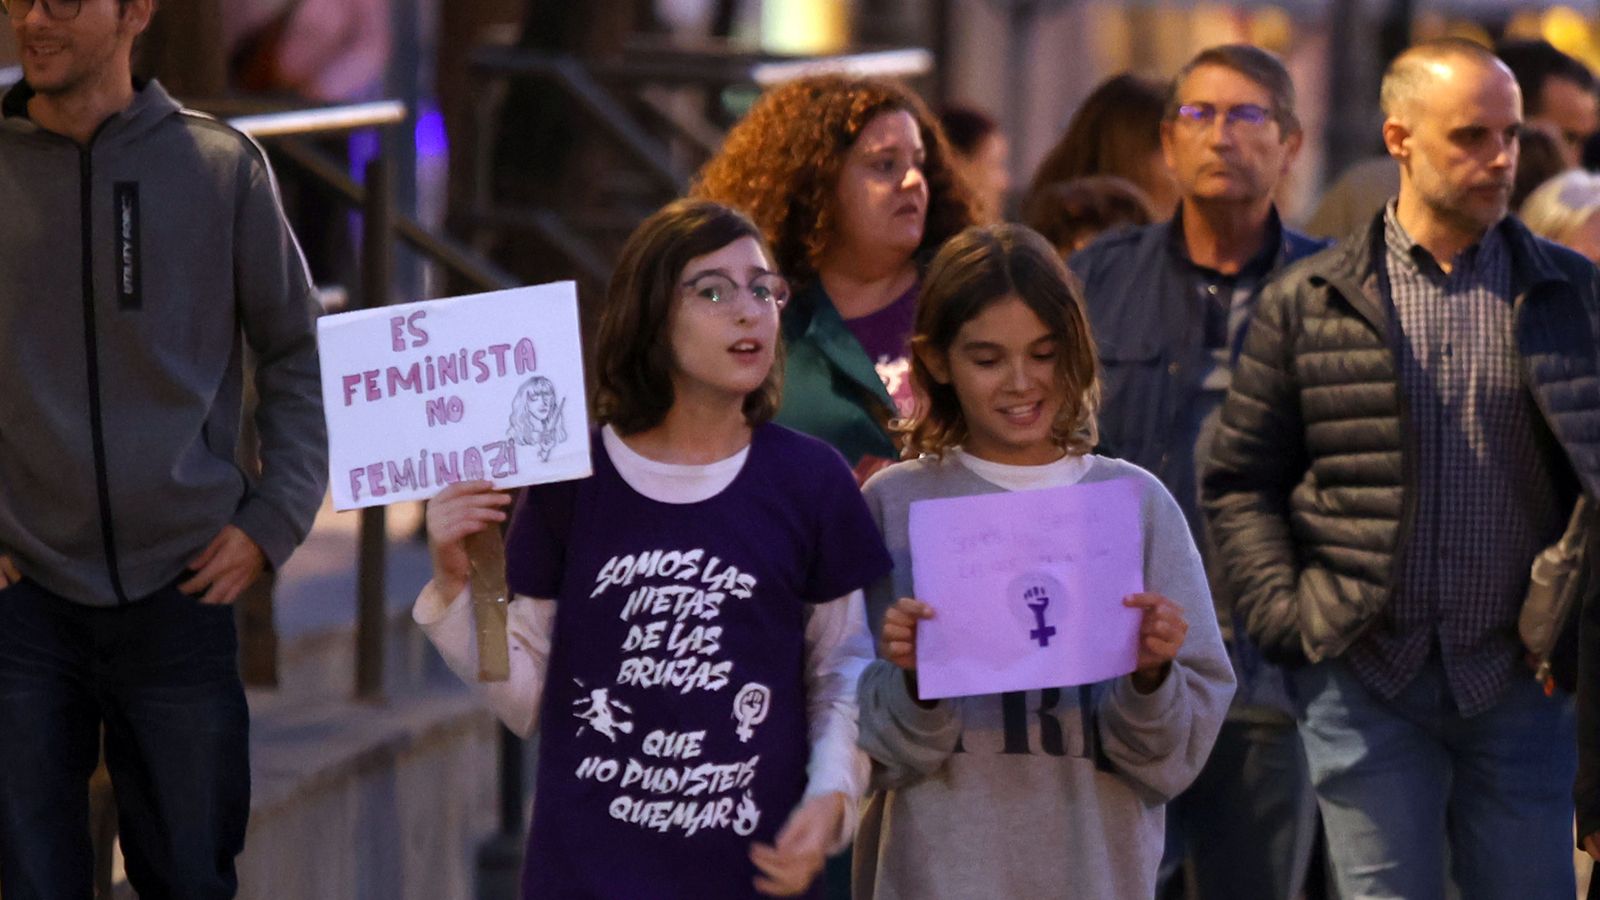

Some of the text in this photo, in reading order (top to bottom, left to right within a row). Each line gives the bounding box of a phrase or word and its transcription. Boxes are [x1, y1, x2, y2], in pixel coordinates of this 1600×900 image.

[390, 310, 429, 352] ES
[426, 395, 465, 427] NO
[589, 548, 757, 600] SOMOS LAS
[619, 585, 726, 622] NIETAS
[621, 620, 723, 658] DE LAS
[616, 656, 734, 695] BRUJAS
[642, 729, 707, 760] QUE
[575, 756, 619, 783] NO
[608, 795, 733, 838] QUEMAR
